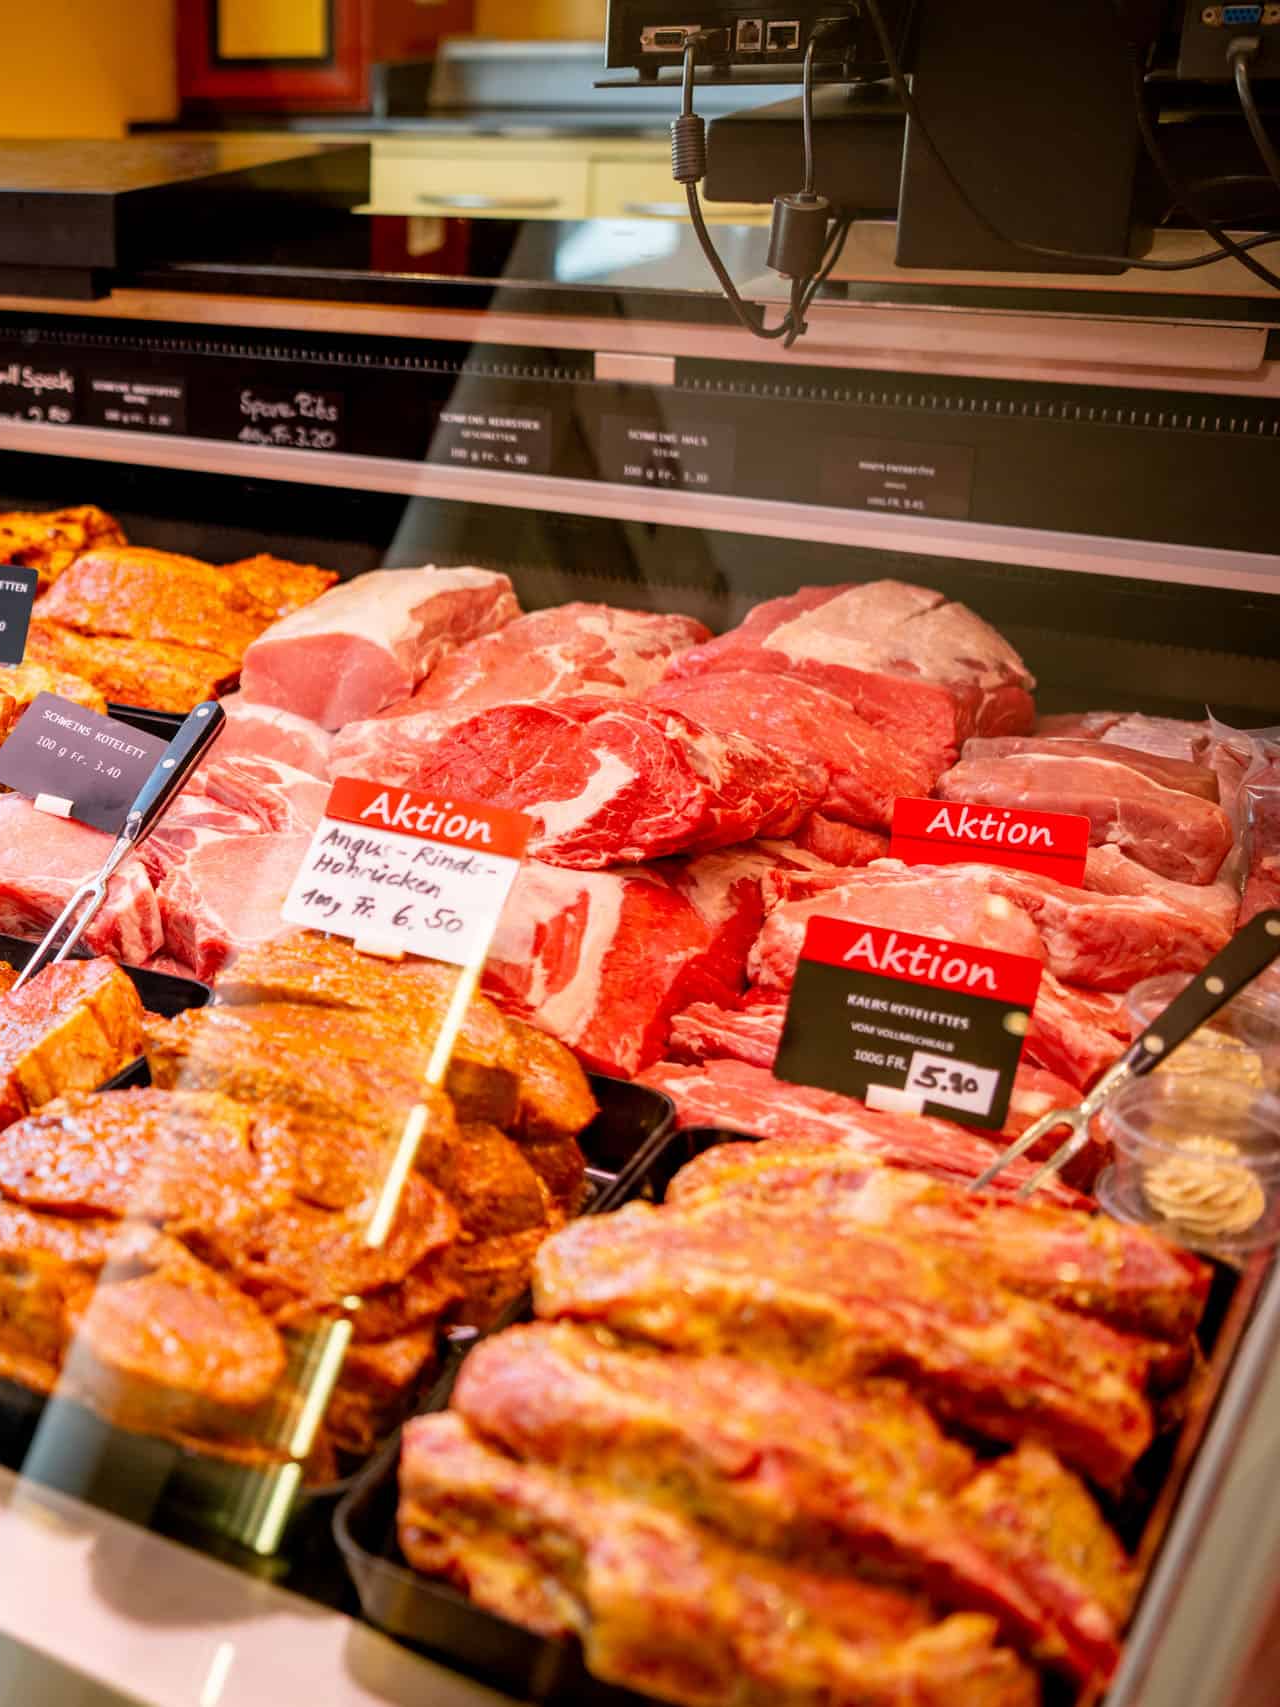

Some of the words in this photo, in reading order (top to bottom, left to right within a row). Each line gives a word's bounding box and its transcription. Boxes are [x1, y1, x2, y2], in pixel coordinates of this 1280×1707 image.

[36, 735, 57, 751] 100
[57, 746, 68, 758] g
[70, 751, 88, 766] Fr.
[94, 759, 122, 780] 3.40
[42, 709, 92, 738] SCHWEINS
[94, 731, 148, 760] KOTELETT
[359, 791, 492, 844] Aktion
[925, 806, 1055, 848] Aktion
[843, 931, 999, 991] Aktion
[853, 1048, 884, 1067] 100G
[886, 1053, 907, 1071] FR.
